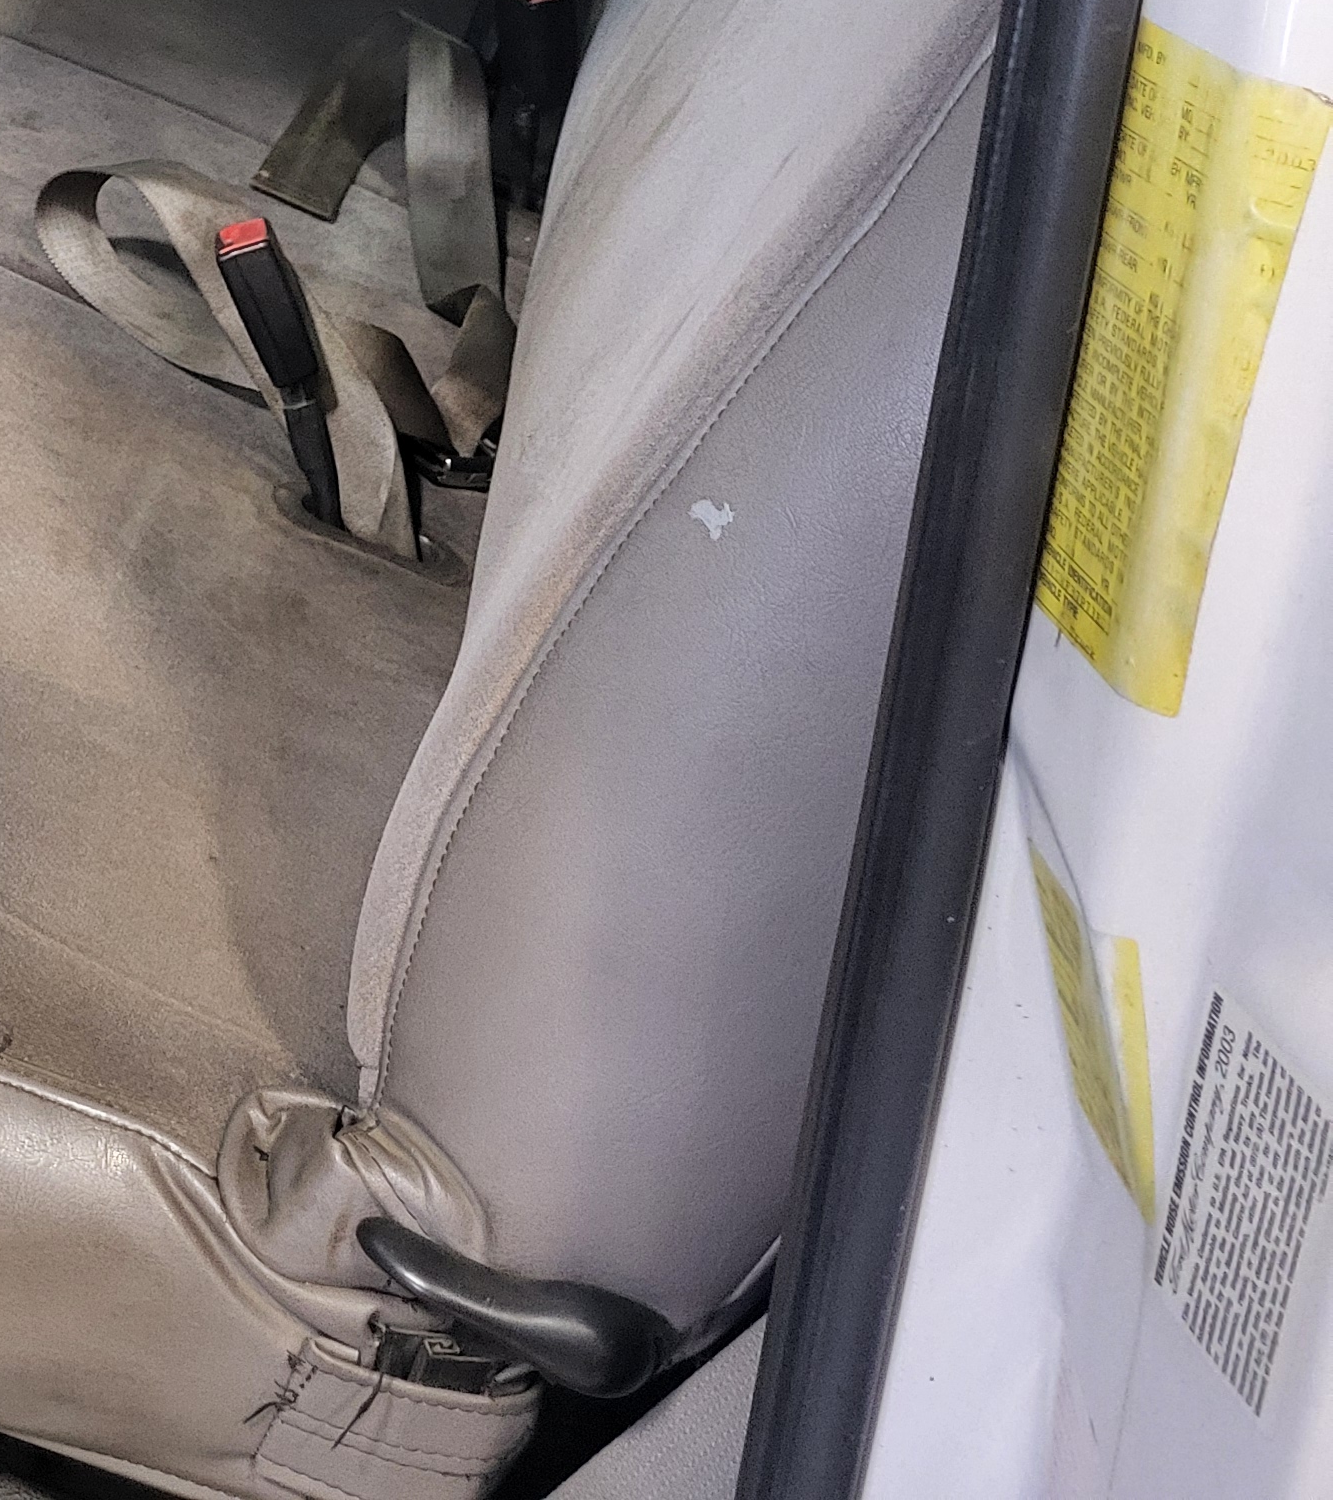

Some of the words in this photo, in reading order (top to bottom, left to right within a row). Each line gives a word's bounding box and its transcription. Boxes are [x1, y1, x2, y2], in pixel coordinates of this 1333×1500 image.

[1111, 302, 1146, 340] FEDERAL
[1097, 330, 1138, 375] PREVIOUSLY
[1095, 446, 1139, 499] ACCORDANCE
[1073, 505, 1104, 544] FEDERAL
[1074, 523, 1115, 575] STANDARDS
[1067, 562, 1113, 619] IDENTIFICATION
[1214, 1022, 1235, 1081] 2003
[1154, 1233, 1170, 1287] VEHICLE
[1164, 1195, 1177, 1236] NOISE
[1172, 1135, 1190, 1198] EMISSION
[1184, 1078, 1202, 1138] CONTROL
[1197, 990, 1222, 1080] INFORMATION
